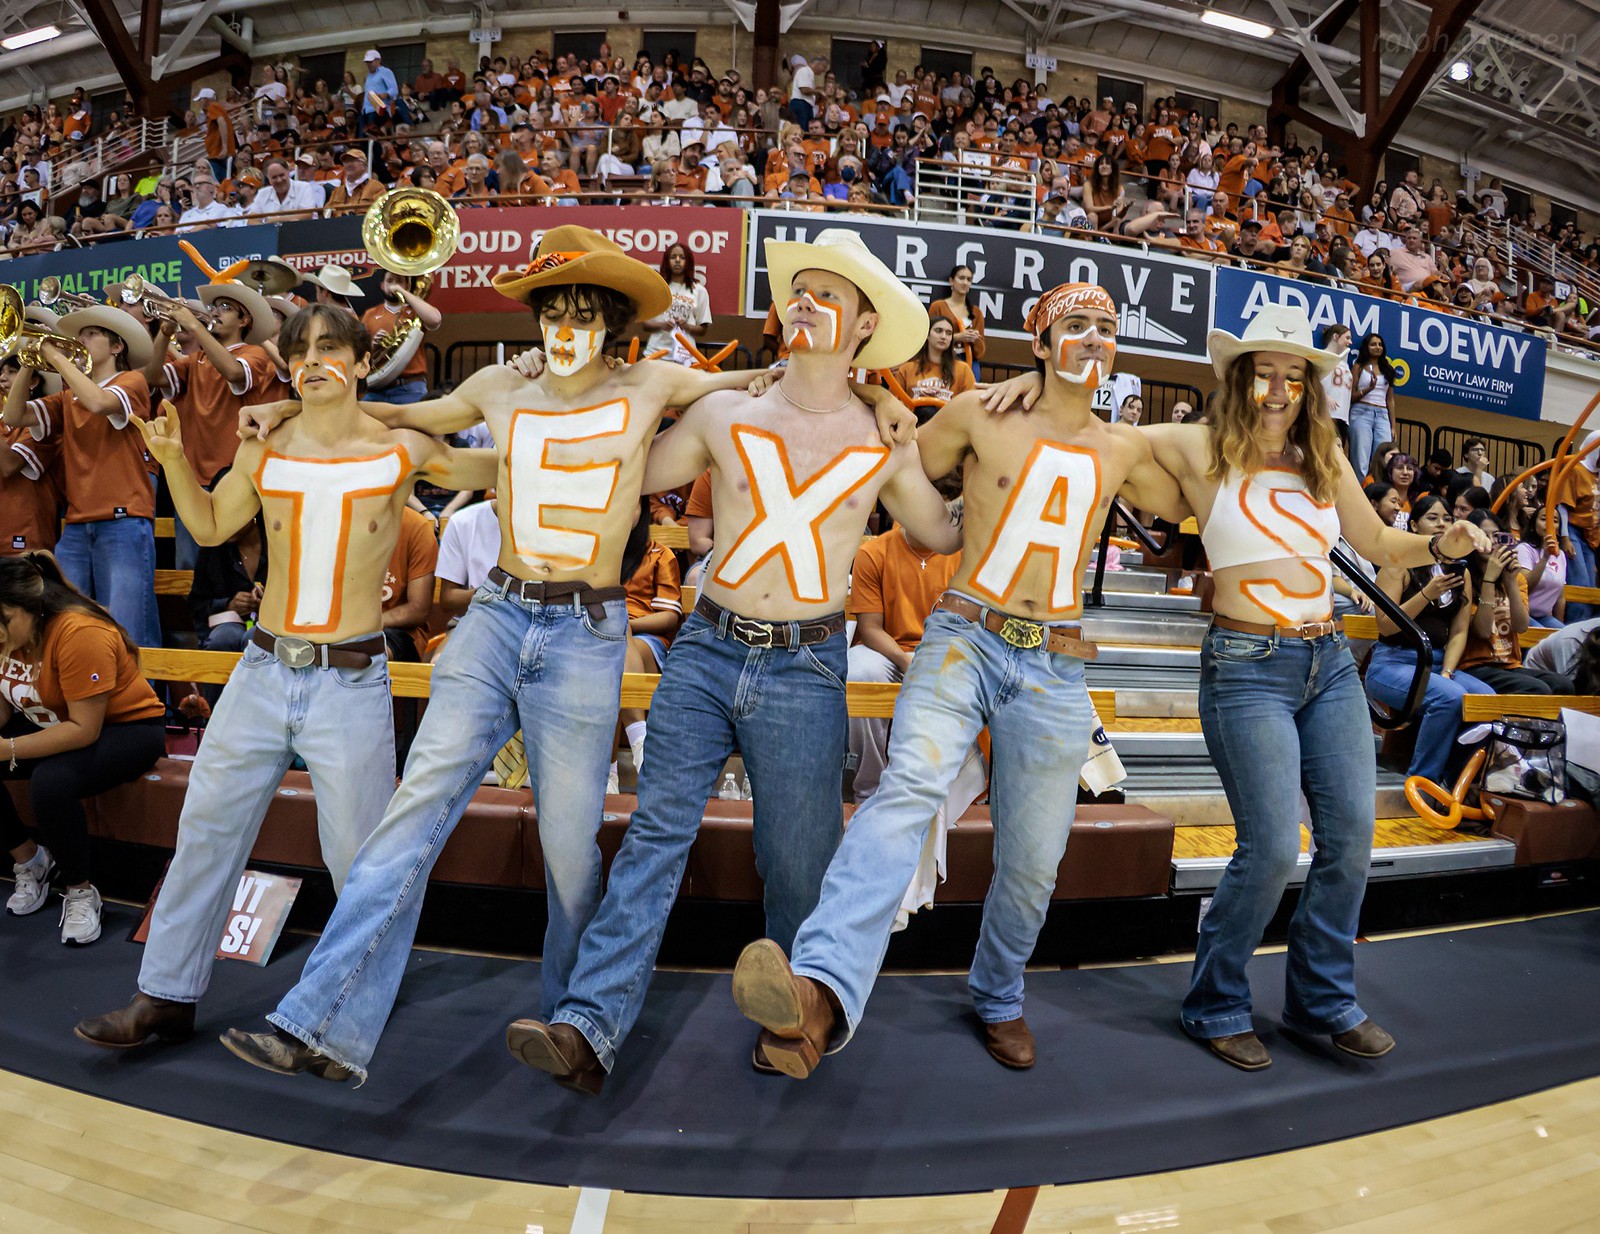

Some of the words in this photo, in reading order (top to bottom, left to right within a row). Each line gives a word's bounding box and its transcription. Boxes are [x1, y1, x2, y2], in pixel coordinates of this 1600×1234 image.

[688, 230, 730, 254] OF
[286, 252, 377, 269] FIREHOUS
[1400, 310, 1531, 374] LOEWY
[1423, 364, 1464, 384] LOEWY
[1465, 373, 1490, 388] LAW
[1491, 378, 1514, 394] FIRM
[1095, 389, 1112, 407] 12
[1428, 385, 1455, 395] HELPING
[1458, 391, 1483, 401] INJURED
[253, 443, 414, 633] T
[507, 397, 630, 570] E
[713, 423, 892, 604] X
[968, 437, 1101, 614] A
[1239, 466, 1336, 628] S
